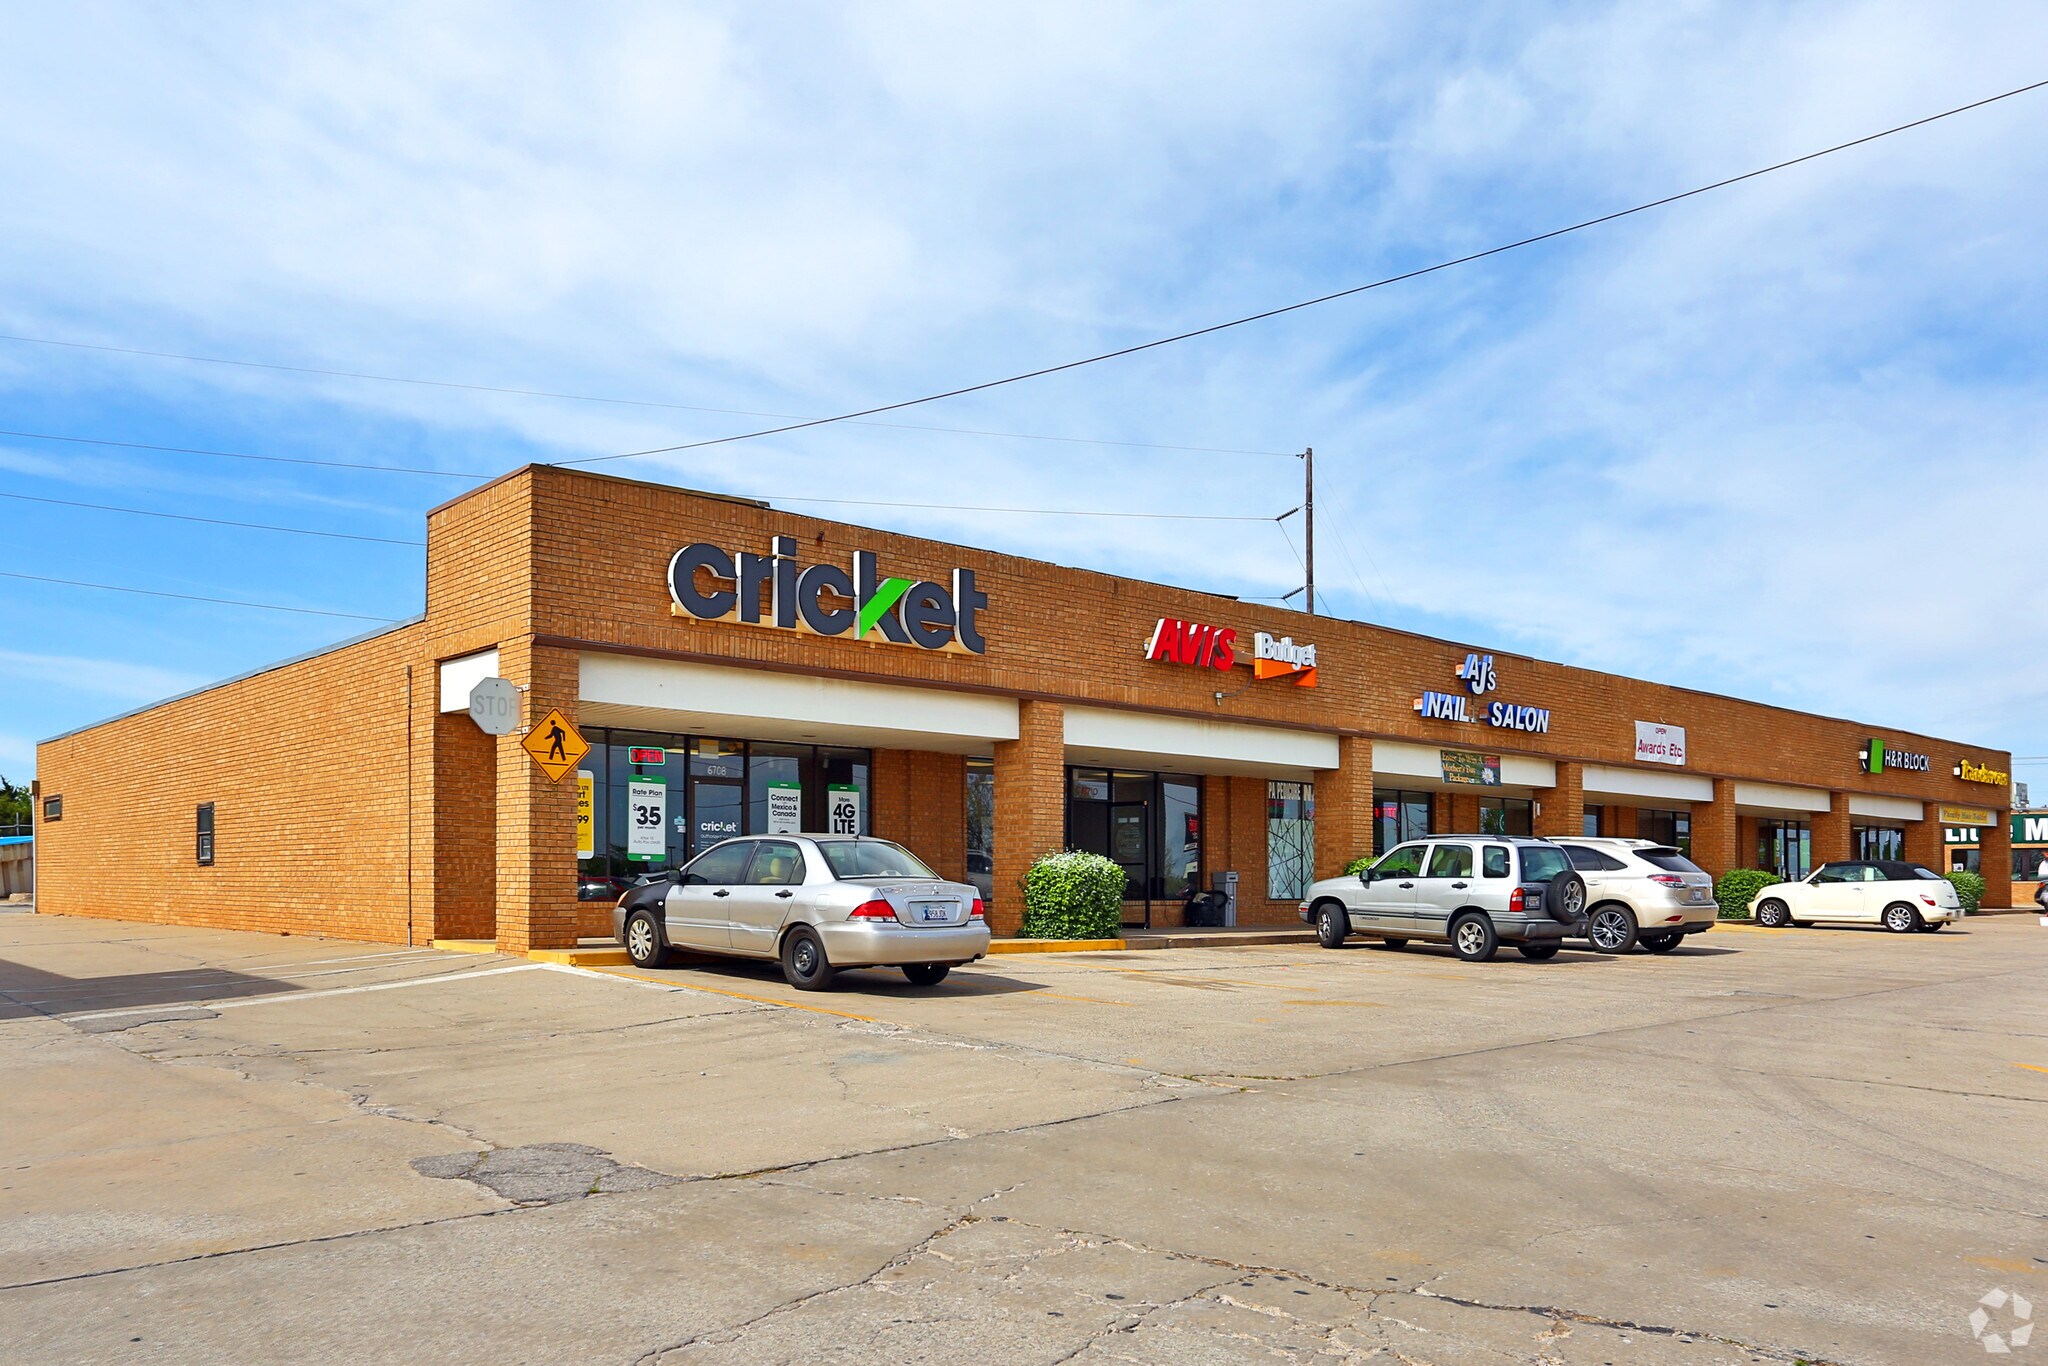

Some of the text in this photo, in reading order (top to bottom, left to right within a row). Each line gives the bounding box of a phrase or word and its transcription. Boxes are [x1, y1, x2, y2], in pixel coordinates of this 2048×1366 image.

[667, 535, 987, 655] cricket
[1145, 617, 1237, 672] AVIS
[1254, 632, 1317, 670] Budget
[1460, 653, 1496, 695] AJ's
[474, 694, 517, 717] STOP
[1422, 691, 1550, 733] NAIL SALON
[631, 748, 664, 763] OPEN
[1442, 752, 1457, 762] Enter
[1638, 739, 1683, 757] Awards Etc
[1442, 763, 1465, 773] Mother's
[1885, 750, 1930, 772] H&R BLOCK
[707, 765, 727, 776] 6708
[771, 794, 798, 802] Connect
[633, 803, 661, 826] $35
[833, 803, 855, 819] 4G
[701, 821, 737, 832] cricket
[834, 819, 855, 834] LTE
